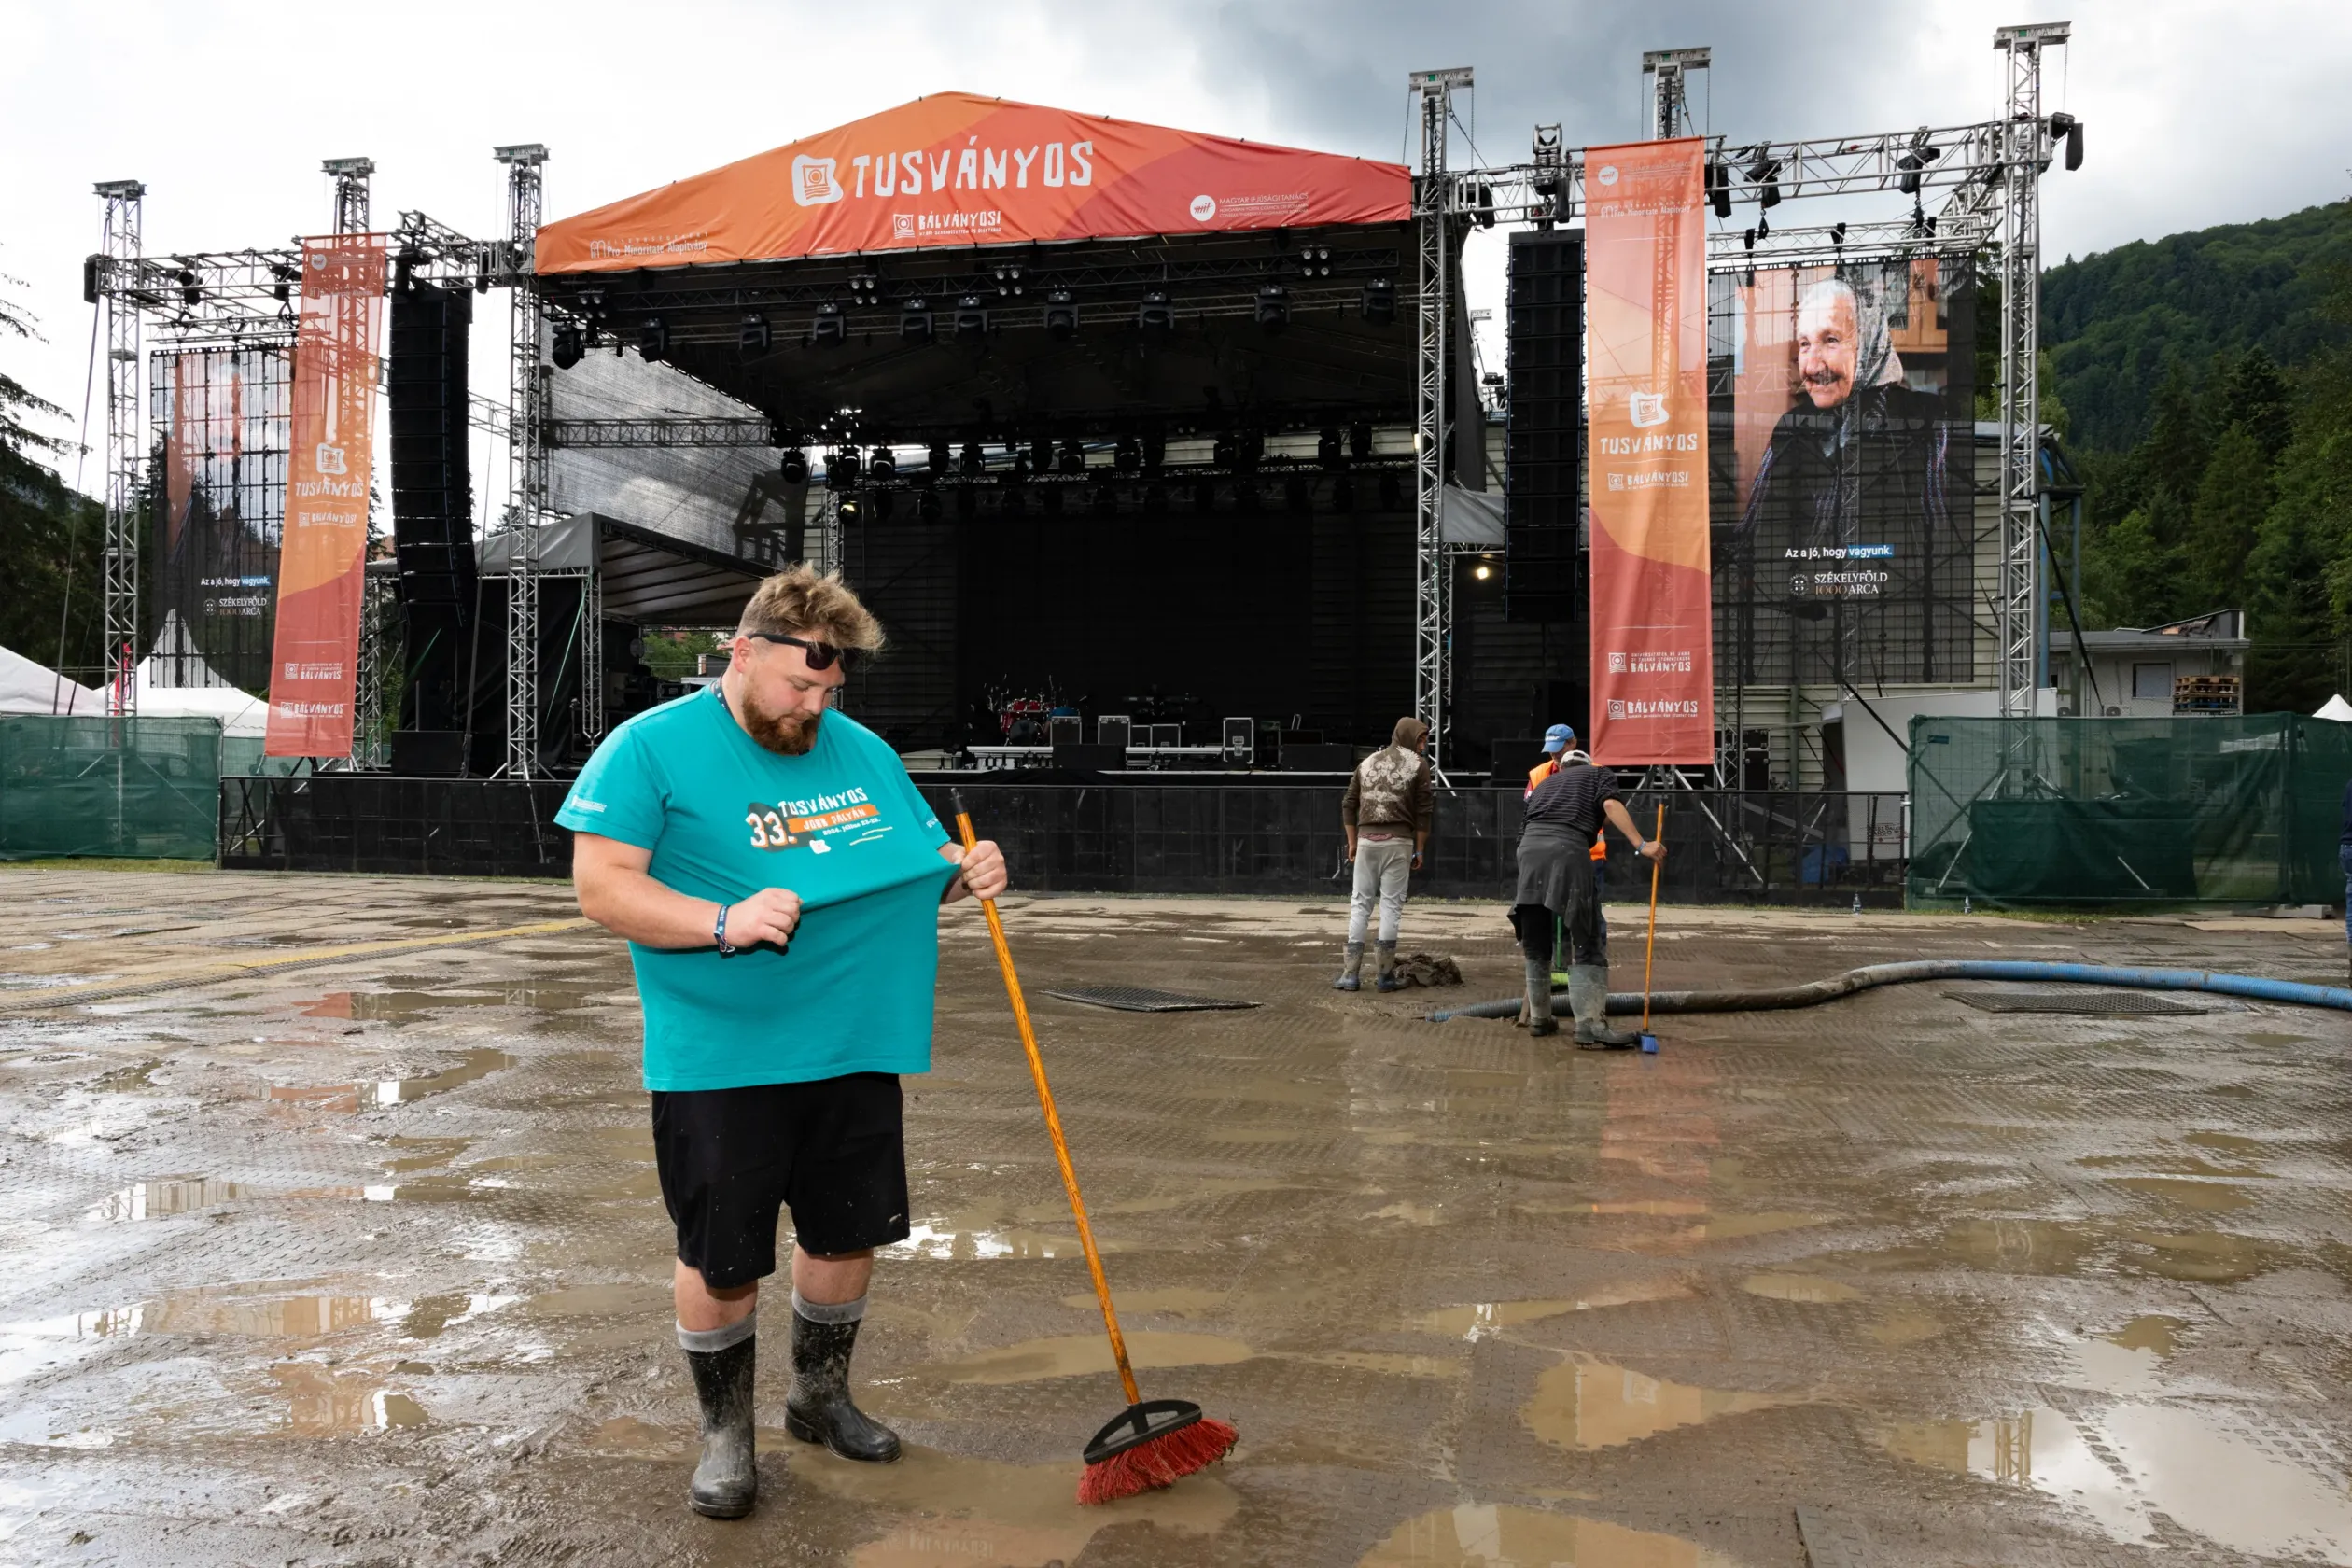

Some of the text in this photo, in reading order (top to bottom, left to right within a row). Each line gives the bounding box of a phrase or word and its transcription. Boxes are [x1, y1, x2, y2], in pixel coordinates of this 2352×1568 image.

[853, 135, 1093, 198] TUSVÁNYOS
[1219, 196, 1250, 204] MAGYAR
[1281, 192, 1309, 202] TANÁCS
[918, 210, 1001, 230] BÁLVÁNYOSI
[608, 239, 707, 258] Pro Minoritate Alapítvány
[1600, 431, 1698, 455] TUSVÁNYOS
[1627, 469, 1688, 485] BÁLVÁNYOSI
[295, 477, 364, 497] TUSVÁNYOS
[1785, 548, 1799, 558] Az
[1808, 547, 1821, 560] jó,
[1823, 547, 1847, 559] hogy
[1848, 545, 1893, 559] vagyunk.
[201, 578, 210, 586] Az
[215, 577, 224, 587] jó,
[224, 577, 240, 587] hogy
[241, 576, 271, 587] vagyunk.
[1814, 570, 1888, 584] SZÉKELYFÖLD
[1848, 584, 1879, 595] ARCA
[219, 595, 267, 607] SZÉKELYFÖLD
[241, 607, 261, 616] ARCA
[1631, 660, 1691, 672] BÁLVÁNYOS
[1628, 699, 1698, 714] BÁLVÁNYOS
[778, 787, 868, 818] TUSVÁNYOS
[804, 808, 866, 830] JOBB PÁLYÁN
[746, 811, 798, 847] 33.
